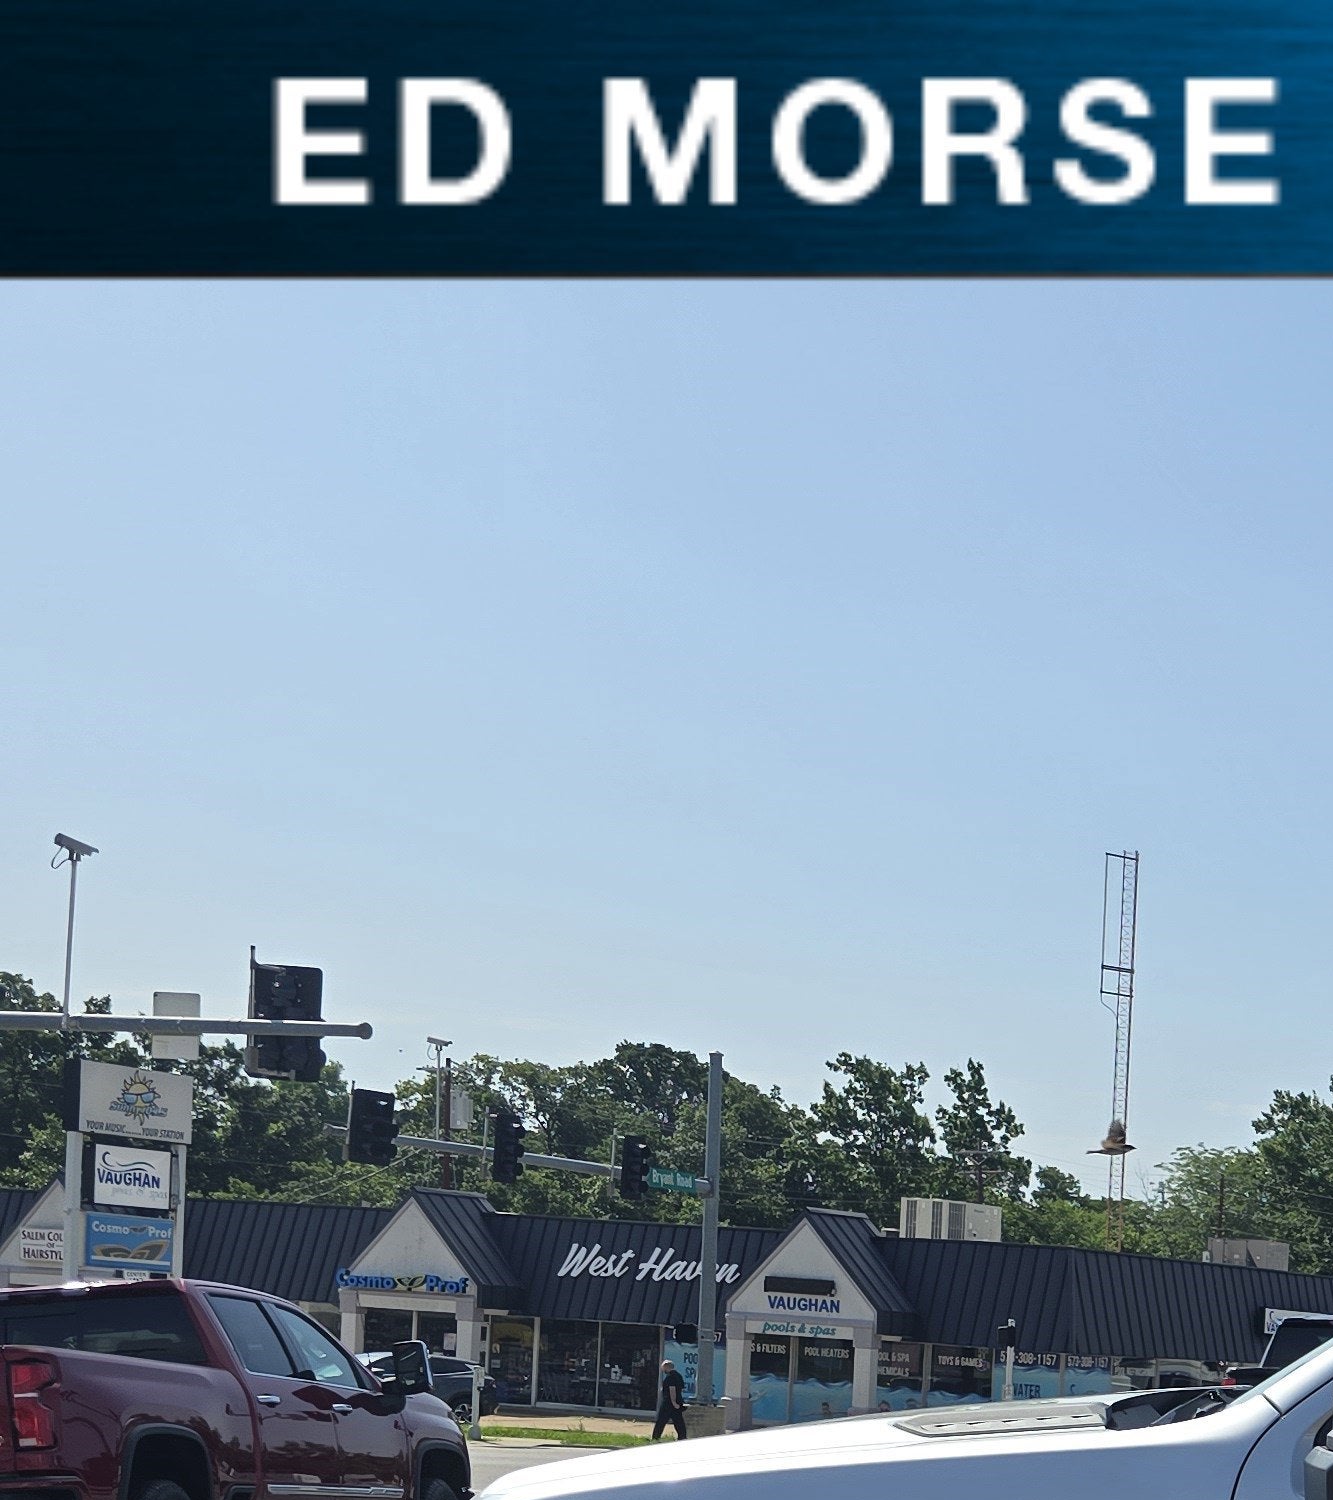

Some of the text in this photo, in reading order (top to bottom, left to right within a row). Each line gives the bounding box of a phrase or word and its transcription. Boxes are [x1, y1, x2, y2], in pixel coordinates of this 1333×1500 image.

[86, 1120, 104, 1130] YOUR
[142, 1128, 158, 1138] YOUR
[159, 1130, 184, 1140] STATION
[97, 1167, 160, 1189] VAUGHAN
[21, 1230, 64, 1242] SALEM COL
[91, 1220, 172, 1239] Cosmo Prof
[22, 1247, 64, 1261] HAIRSTYL
[557, 1242, 741, 1284] West Havn
[335, 1267, 469, 1294] Cosmo Prof
[767, 1294, 841, 1314] VAUGHAN
[762, 1321, 837, 1337] pools & spas
[762, 1343, 787, 1355] FILTERS
[804, 1346, 850, 1359] POOL HEATERS
[878, 1351, 890, 1362] OOL
[683, 1352, 698, 1365] POO
[938, 1355, 954, 1366] TOYS
[960, 1357, 983, 1368] GAMES
[1000, 1350, 1057, 1366] 5-308-1157
[878, 1366, 910, 1378] HEMICALS
